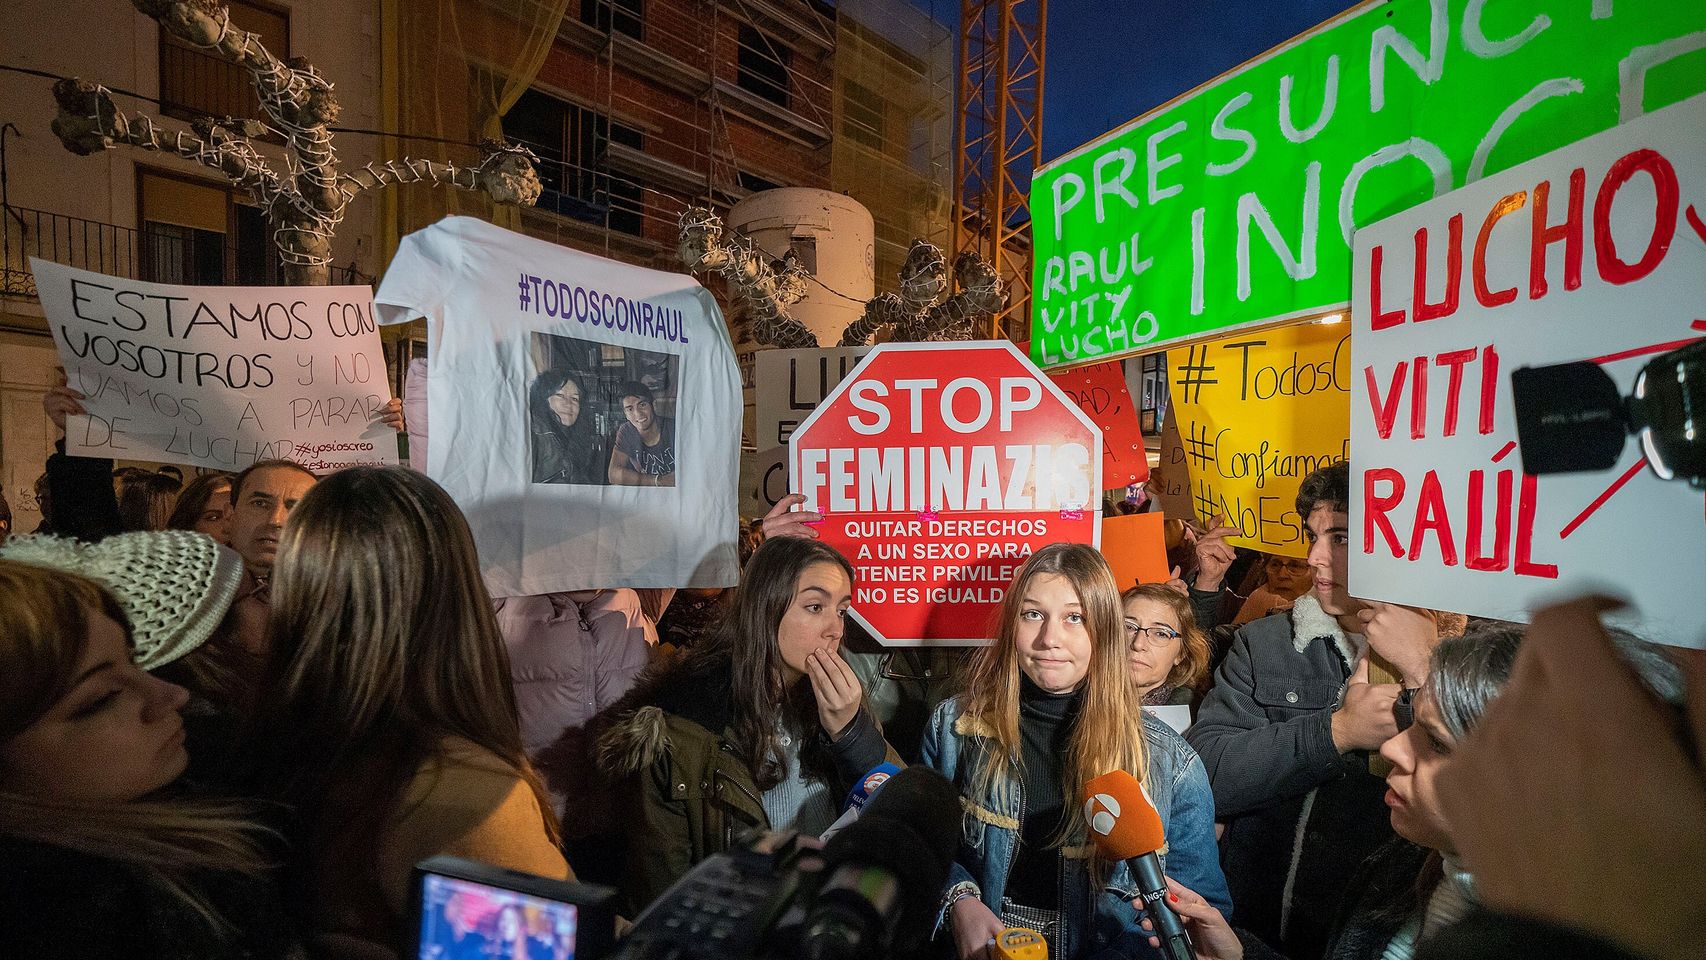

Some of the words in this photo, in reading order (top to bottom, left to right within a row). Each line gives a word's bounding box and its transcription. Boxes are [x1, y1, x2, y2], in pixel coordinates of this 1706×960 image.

[1052, 0, 1612, 240] PRESUNC
[1042, 232, 1154, 301] RAUL
[1371, 148, 1680, 331] LUCHO
[70, 278, 312, 341] ESTAMOS
[326, 301, 375, 339] CON
[518, 273, 689, 344] #TODOSCONRAUL
[1041, 310, 1159, 365] LUCHO
[61, 325, 273, 389] VOSOTROS
[334, 352, 371, 385] NO
[1176, 334, 1351, 404] #TodosC
[78, 367, 203, 427] VAMOS
[236, 401, 265, 431] A
[289, 394, 384, 429] PARAR
[847, 377, 1042, 436] STOP
[1364, 344, 1500, 440] VITI
[78, 413, 132, 450] DE
[165, 426, 293, 468] LUCHAR
[1186, 421, 1351, 489] #Confiamos
[801, 443, 1090, 512] FEMINAZIS
[1363, 441, 1559, 579] RAÚL
[844, 519, 923, 538] QUITAR
[928, 519, 1047, 536] DERECHOS
[1196, 479, 1305, 547] #NoEs
[853, 565, 925, 582] TENER
[933, 564, 1021, 582] PRIVILE
[857, 543, 873, 560] A
[877, 543, 906, 560] UN
[912, 543, 971, 560] SEXO
[976, 543, 1033, 559] PARA
[857, 587, 887, 604] NO
[893, 587, 919, 604] ES
[926, 587, 1004, 604] IGUALD
